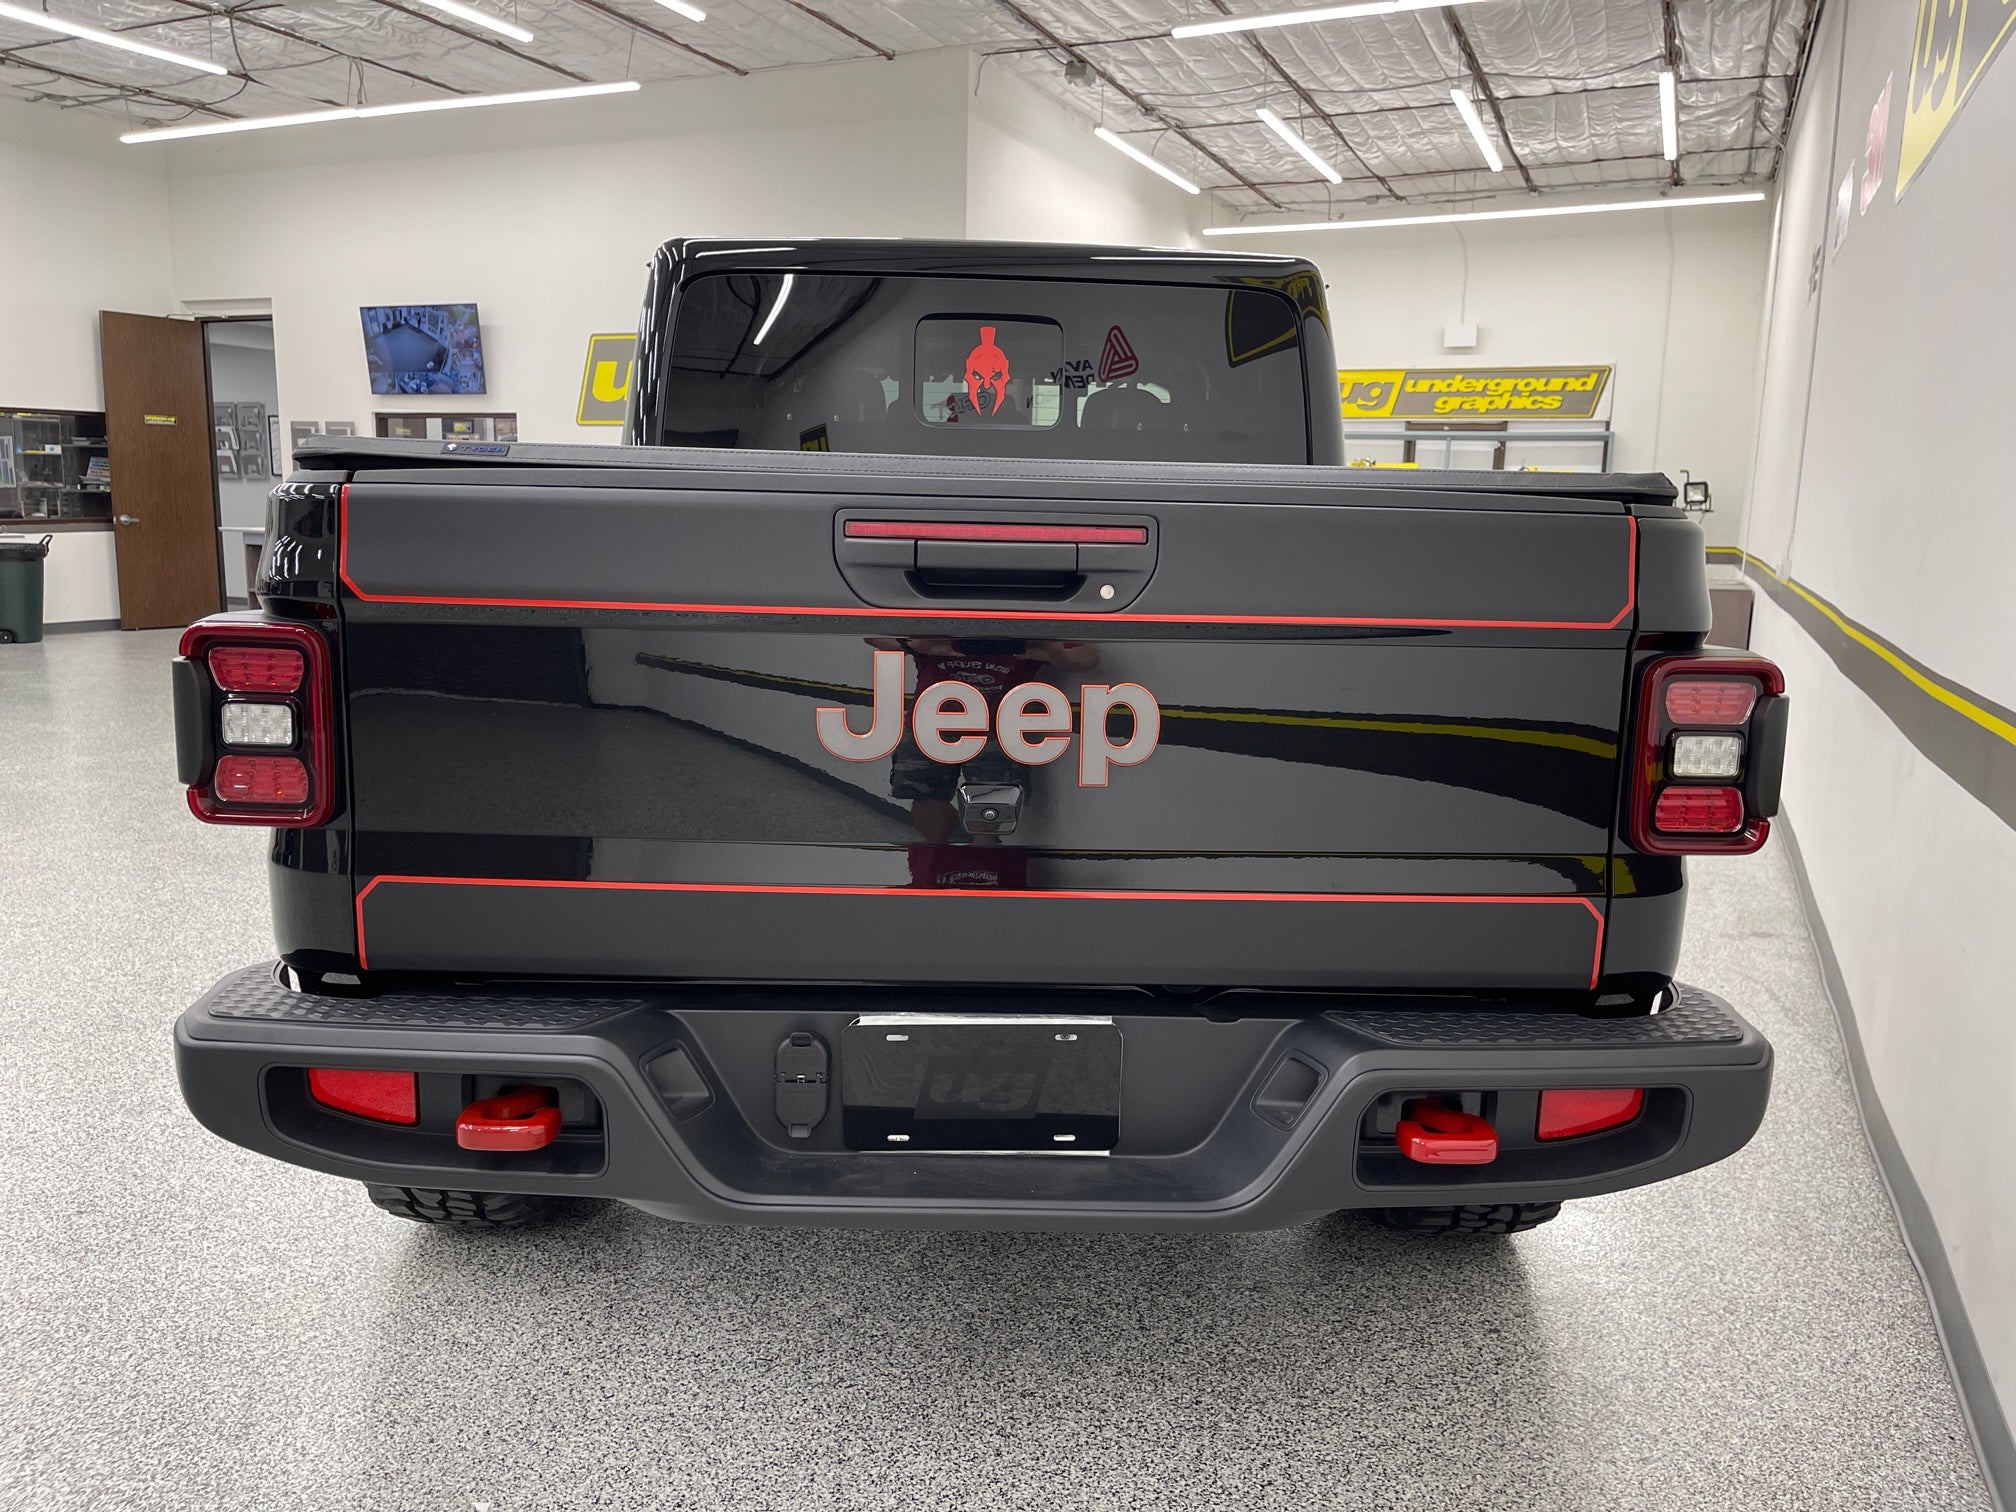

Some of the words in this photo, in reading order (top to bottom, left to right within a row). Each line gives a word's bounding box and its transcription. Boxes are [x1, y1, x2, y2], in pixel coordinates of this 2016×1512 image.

[1404, 372, 1600, 395] underground
[1433, 392, 1563, 413] graphics
[816, 650, 1161, 788] Jeep
